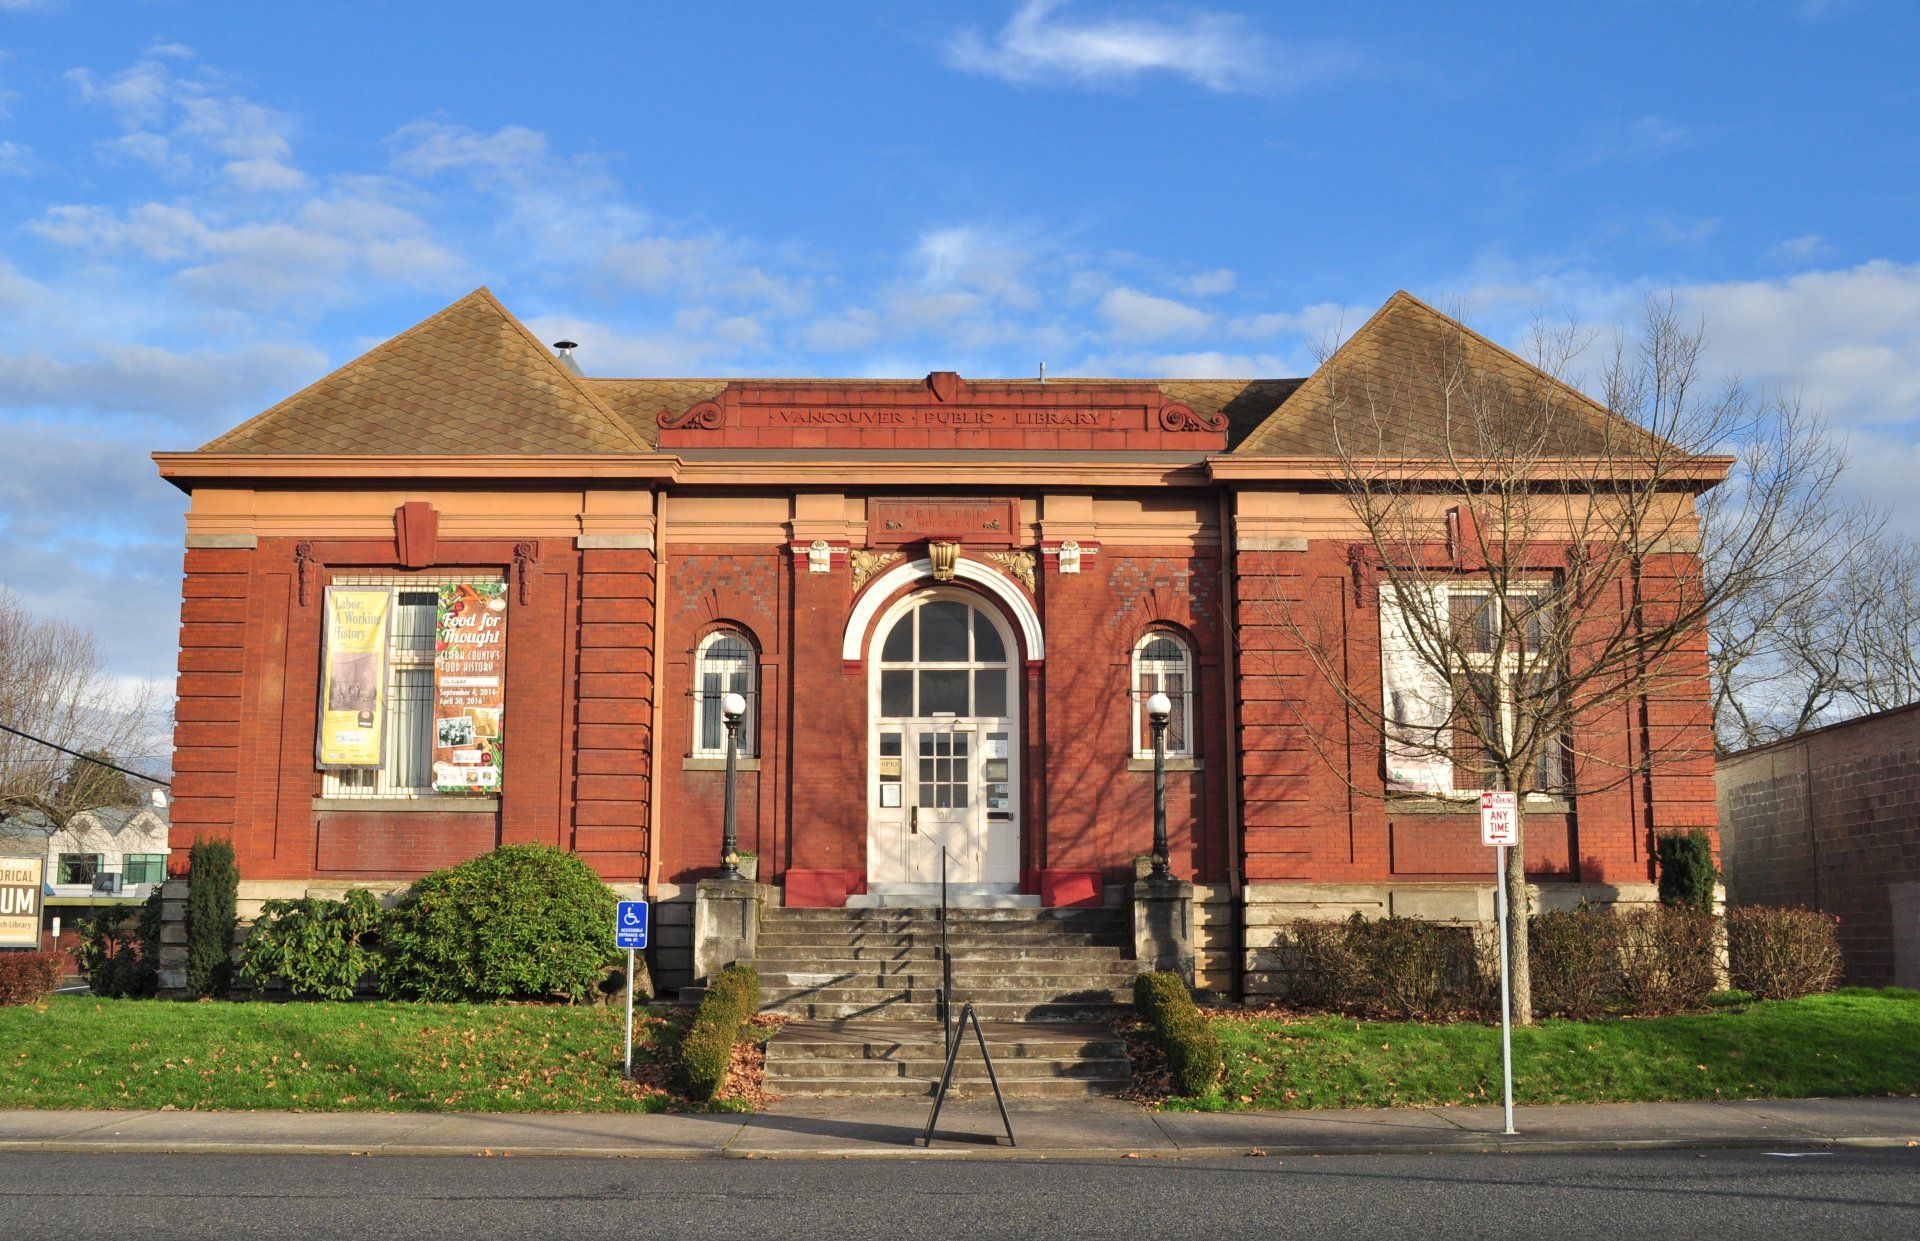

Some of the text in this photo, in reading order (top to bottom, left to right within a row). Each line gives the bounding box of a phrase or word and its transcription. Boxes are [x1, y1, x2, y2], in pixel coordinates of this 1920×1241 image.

[779, 411, 1101, 425] VANCOUVER PUBLIC LIBRARY
[335, 596, 365, 610] Labor:
[335, 611, 382, 627] A Working
[443, 612, 501, 631] Food for
[334, 626, 366, 641] History
[442, 629, 500, 648] Thought
[440, 650, 500, 661] CLARK COUNTY'S
[440, 661, 493, 672] FOOD HISTORY
[439, 688, 470, 697] September
[439, 697, 483, 706] April 30, 2016
[1490, 811, 1508, 820] ANY
[1490, 823, 1510, 833] TIME
[8, 921, 32, 930] Library
